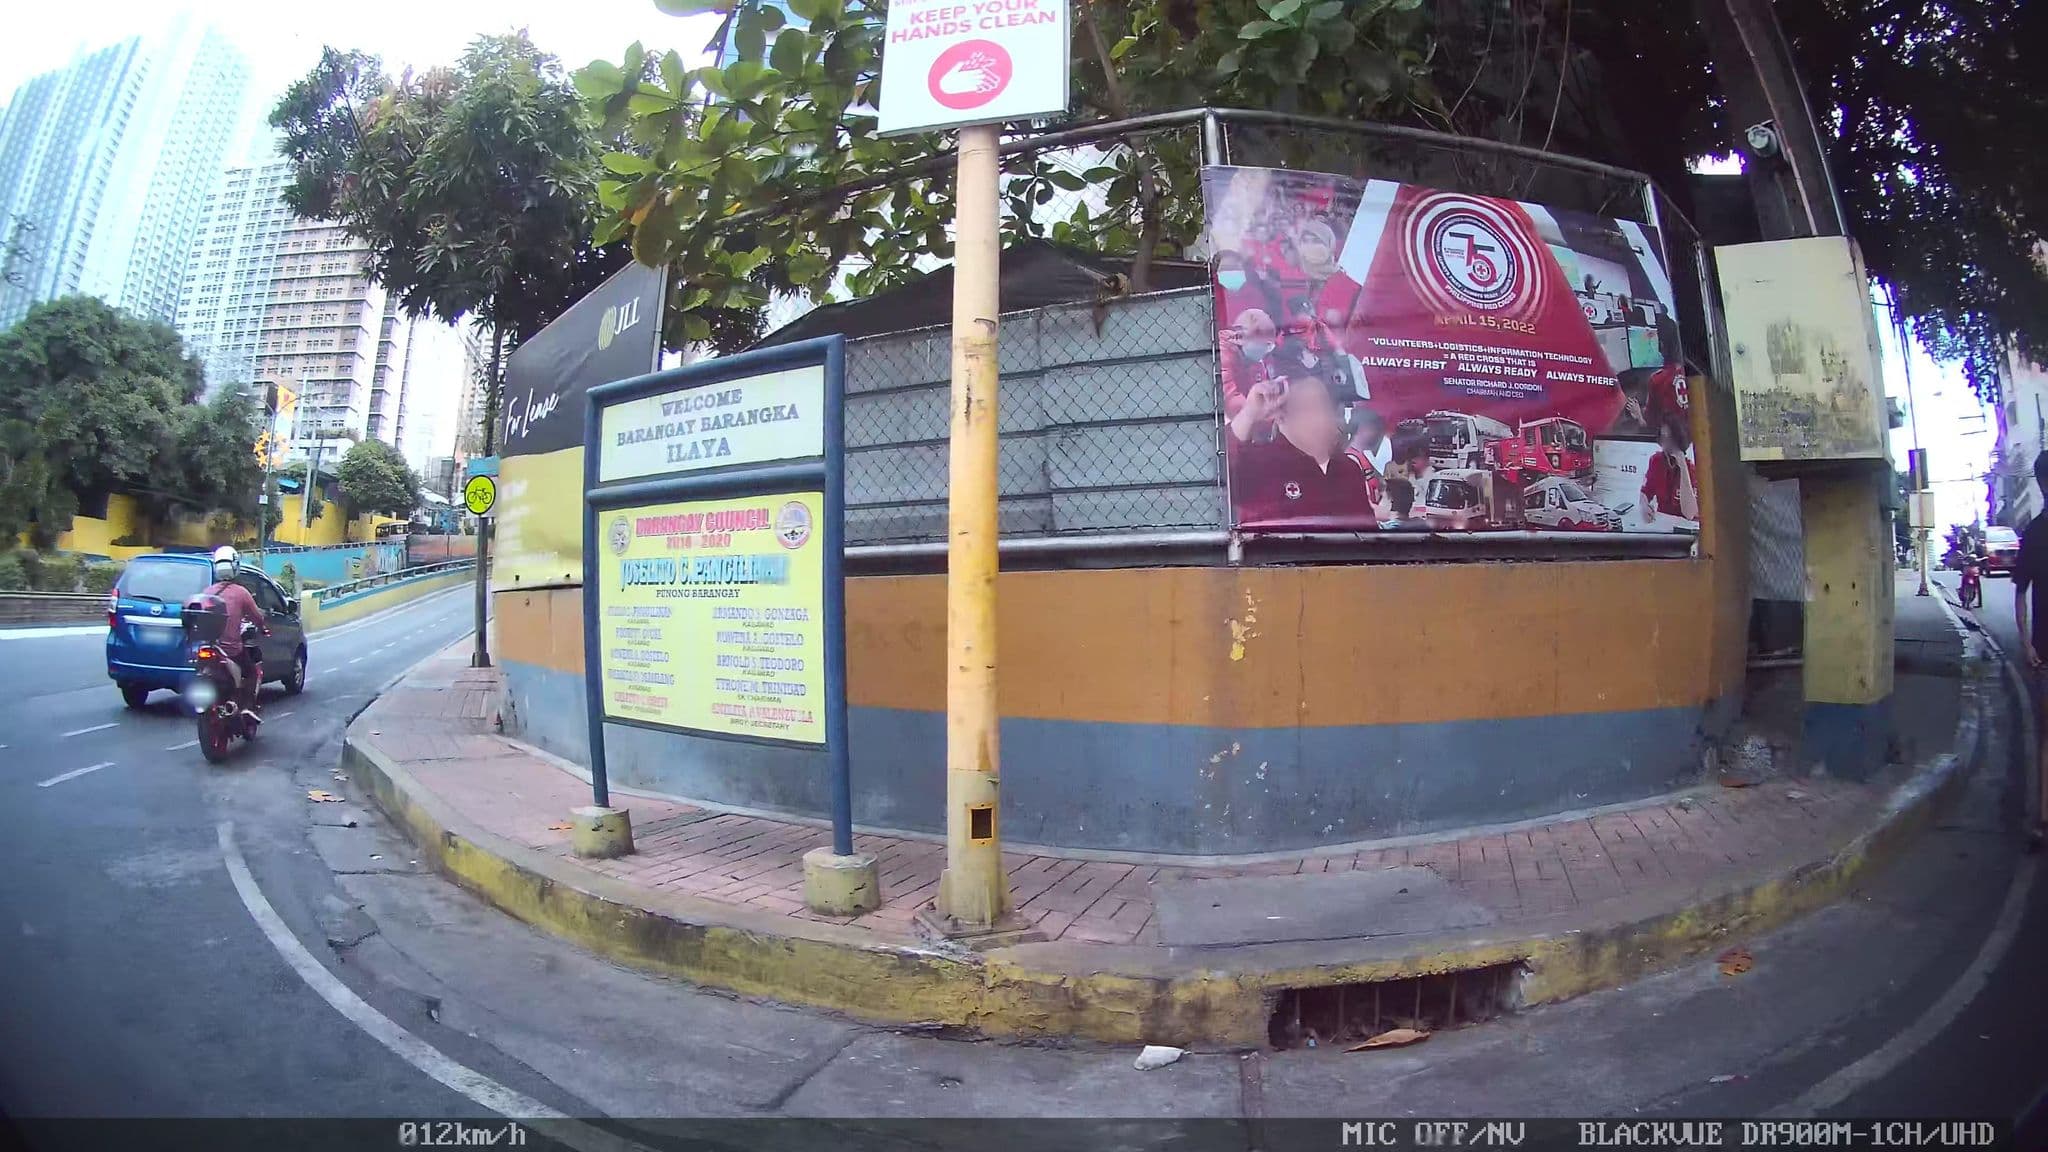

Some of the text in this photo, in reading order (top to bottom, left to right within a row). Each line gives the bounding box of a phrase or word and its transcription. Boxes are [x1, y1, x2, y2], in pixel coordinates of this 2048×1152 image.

[910, 0, 1038, 25] KEEP YOUR
[891, 10, 1056, 44] HANDS CLEAN
[1480, 314, 1500, 330] 15,
[1503, 318, 1536, 335] 2022
[1361, 356, 1411, 368] ALWAYS
[1413, 359, 1448, 371] FIRST
[1457, 362, 1502, 375] ALWAYS
[1504, 365, 1538, 378] READY
[1546, 370, 1585, 384] ALWAYS
[1450, 352, 1457, 361] A
[1458, 352, 1475, 362] RED
[1476, 354, 1505, 364] CROSS
[1506, 357, 1527, 367] THAT
[1528, 359, 1537, 367] IS
[1544, 351, 1593, 365] TECHNOLOGY
[1443, 377, 1476, 387] SENATOR
[1476, 379, 1507, 389] RICHARD
[1514, 383, 1543, 392] GORDON
[1466, 387, 1524, 399] CHAIRMAN AND CEO
[661, 388, 743, 418] WELCOME
[503, 387, 560, 446] For Lease
[616, 403, 800, 447] BARANGAY BARANGKA
[666, 437, 732, 464] ILAYA
[705, 508, 771, 534] COUNCIL
[620, 557, 677, 592] JOSELITO
[656, 588, 741, 598] PUNONG BARANGAY
[759, 656, 804, 671] TEODORO
[761, 681, 807, 696] TRINIDAD
